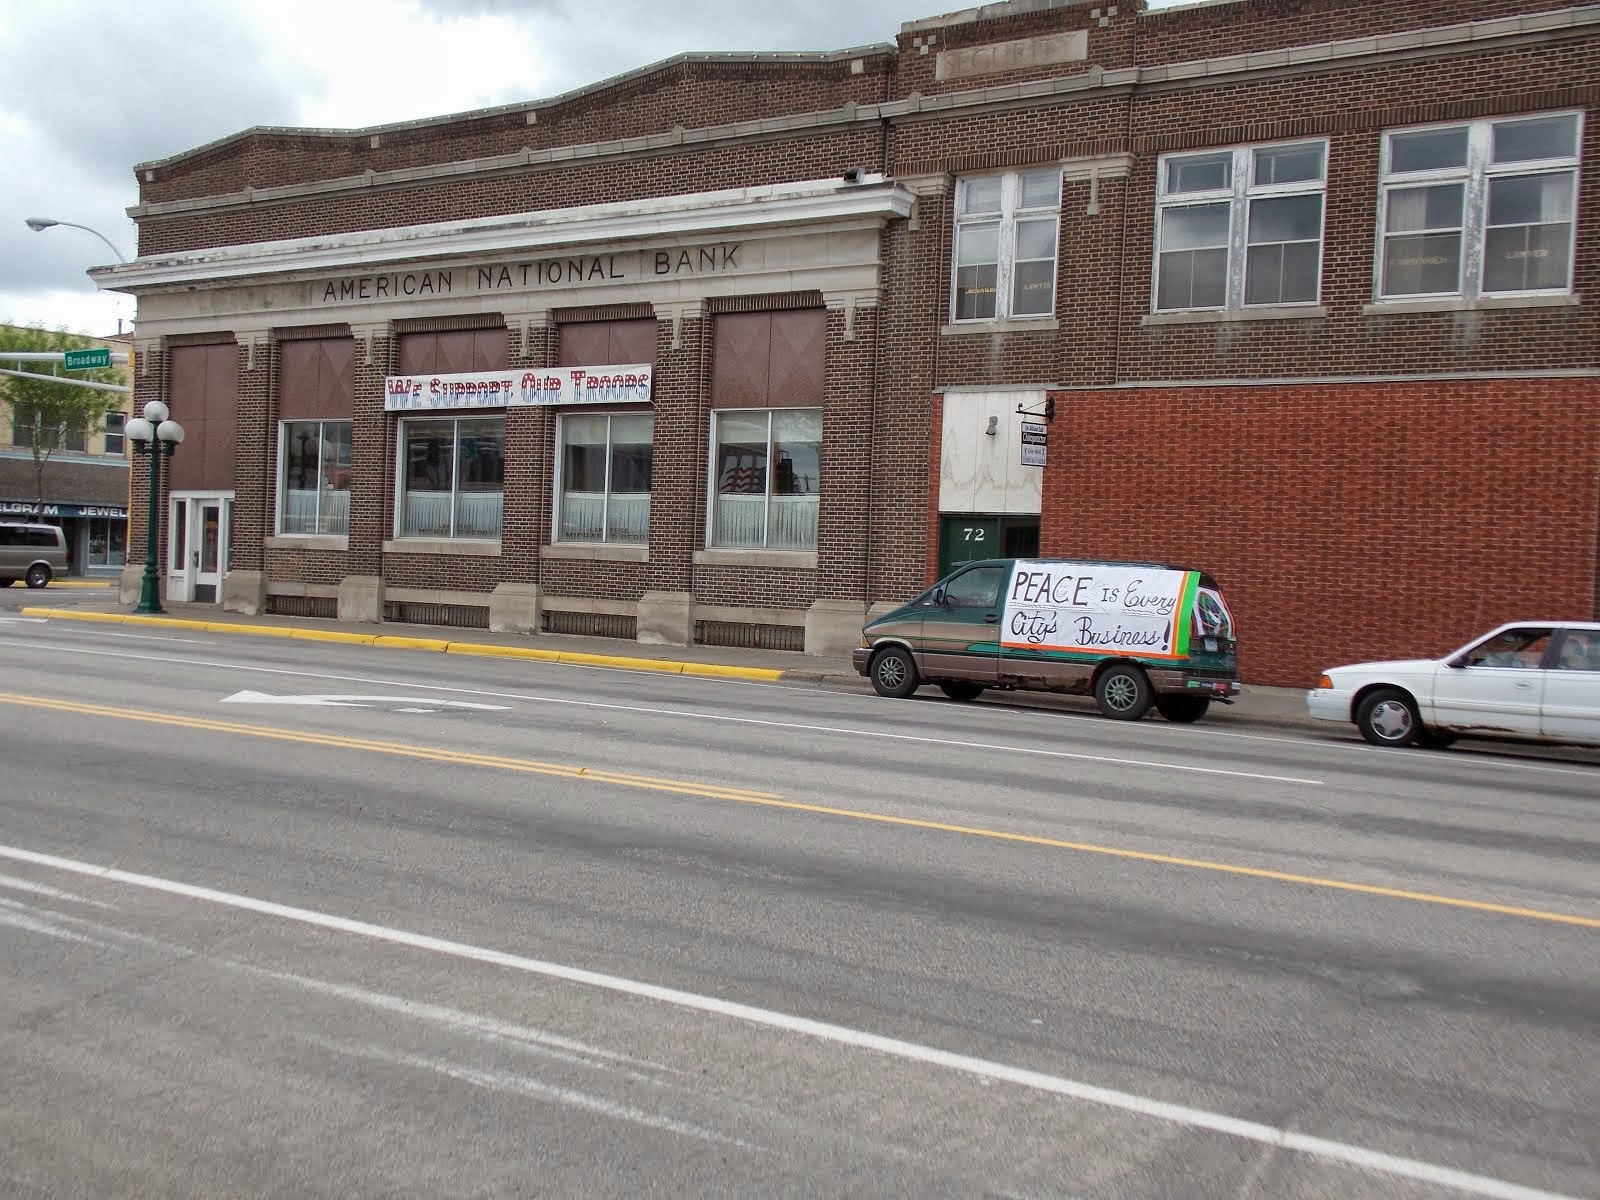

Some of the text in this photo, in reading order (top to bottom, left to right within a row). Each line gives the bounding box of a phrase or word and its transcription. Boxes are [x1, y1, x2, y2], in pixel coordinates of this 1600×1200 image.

[945, 33, 1077, 75] SECURIT
[323, 245, 740, 302] AMERICAN NATIONAL BANK
[67, 354, 107, 366] Broadway
[566, 532, 603, 540] MICHAE
[963, 528, 985, 541] 72
[1012, 571, 1093, 607] PEACE
[1123, 579, 1176, 616] Every
[1010, 610, 1172, 652] City's Business!
